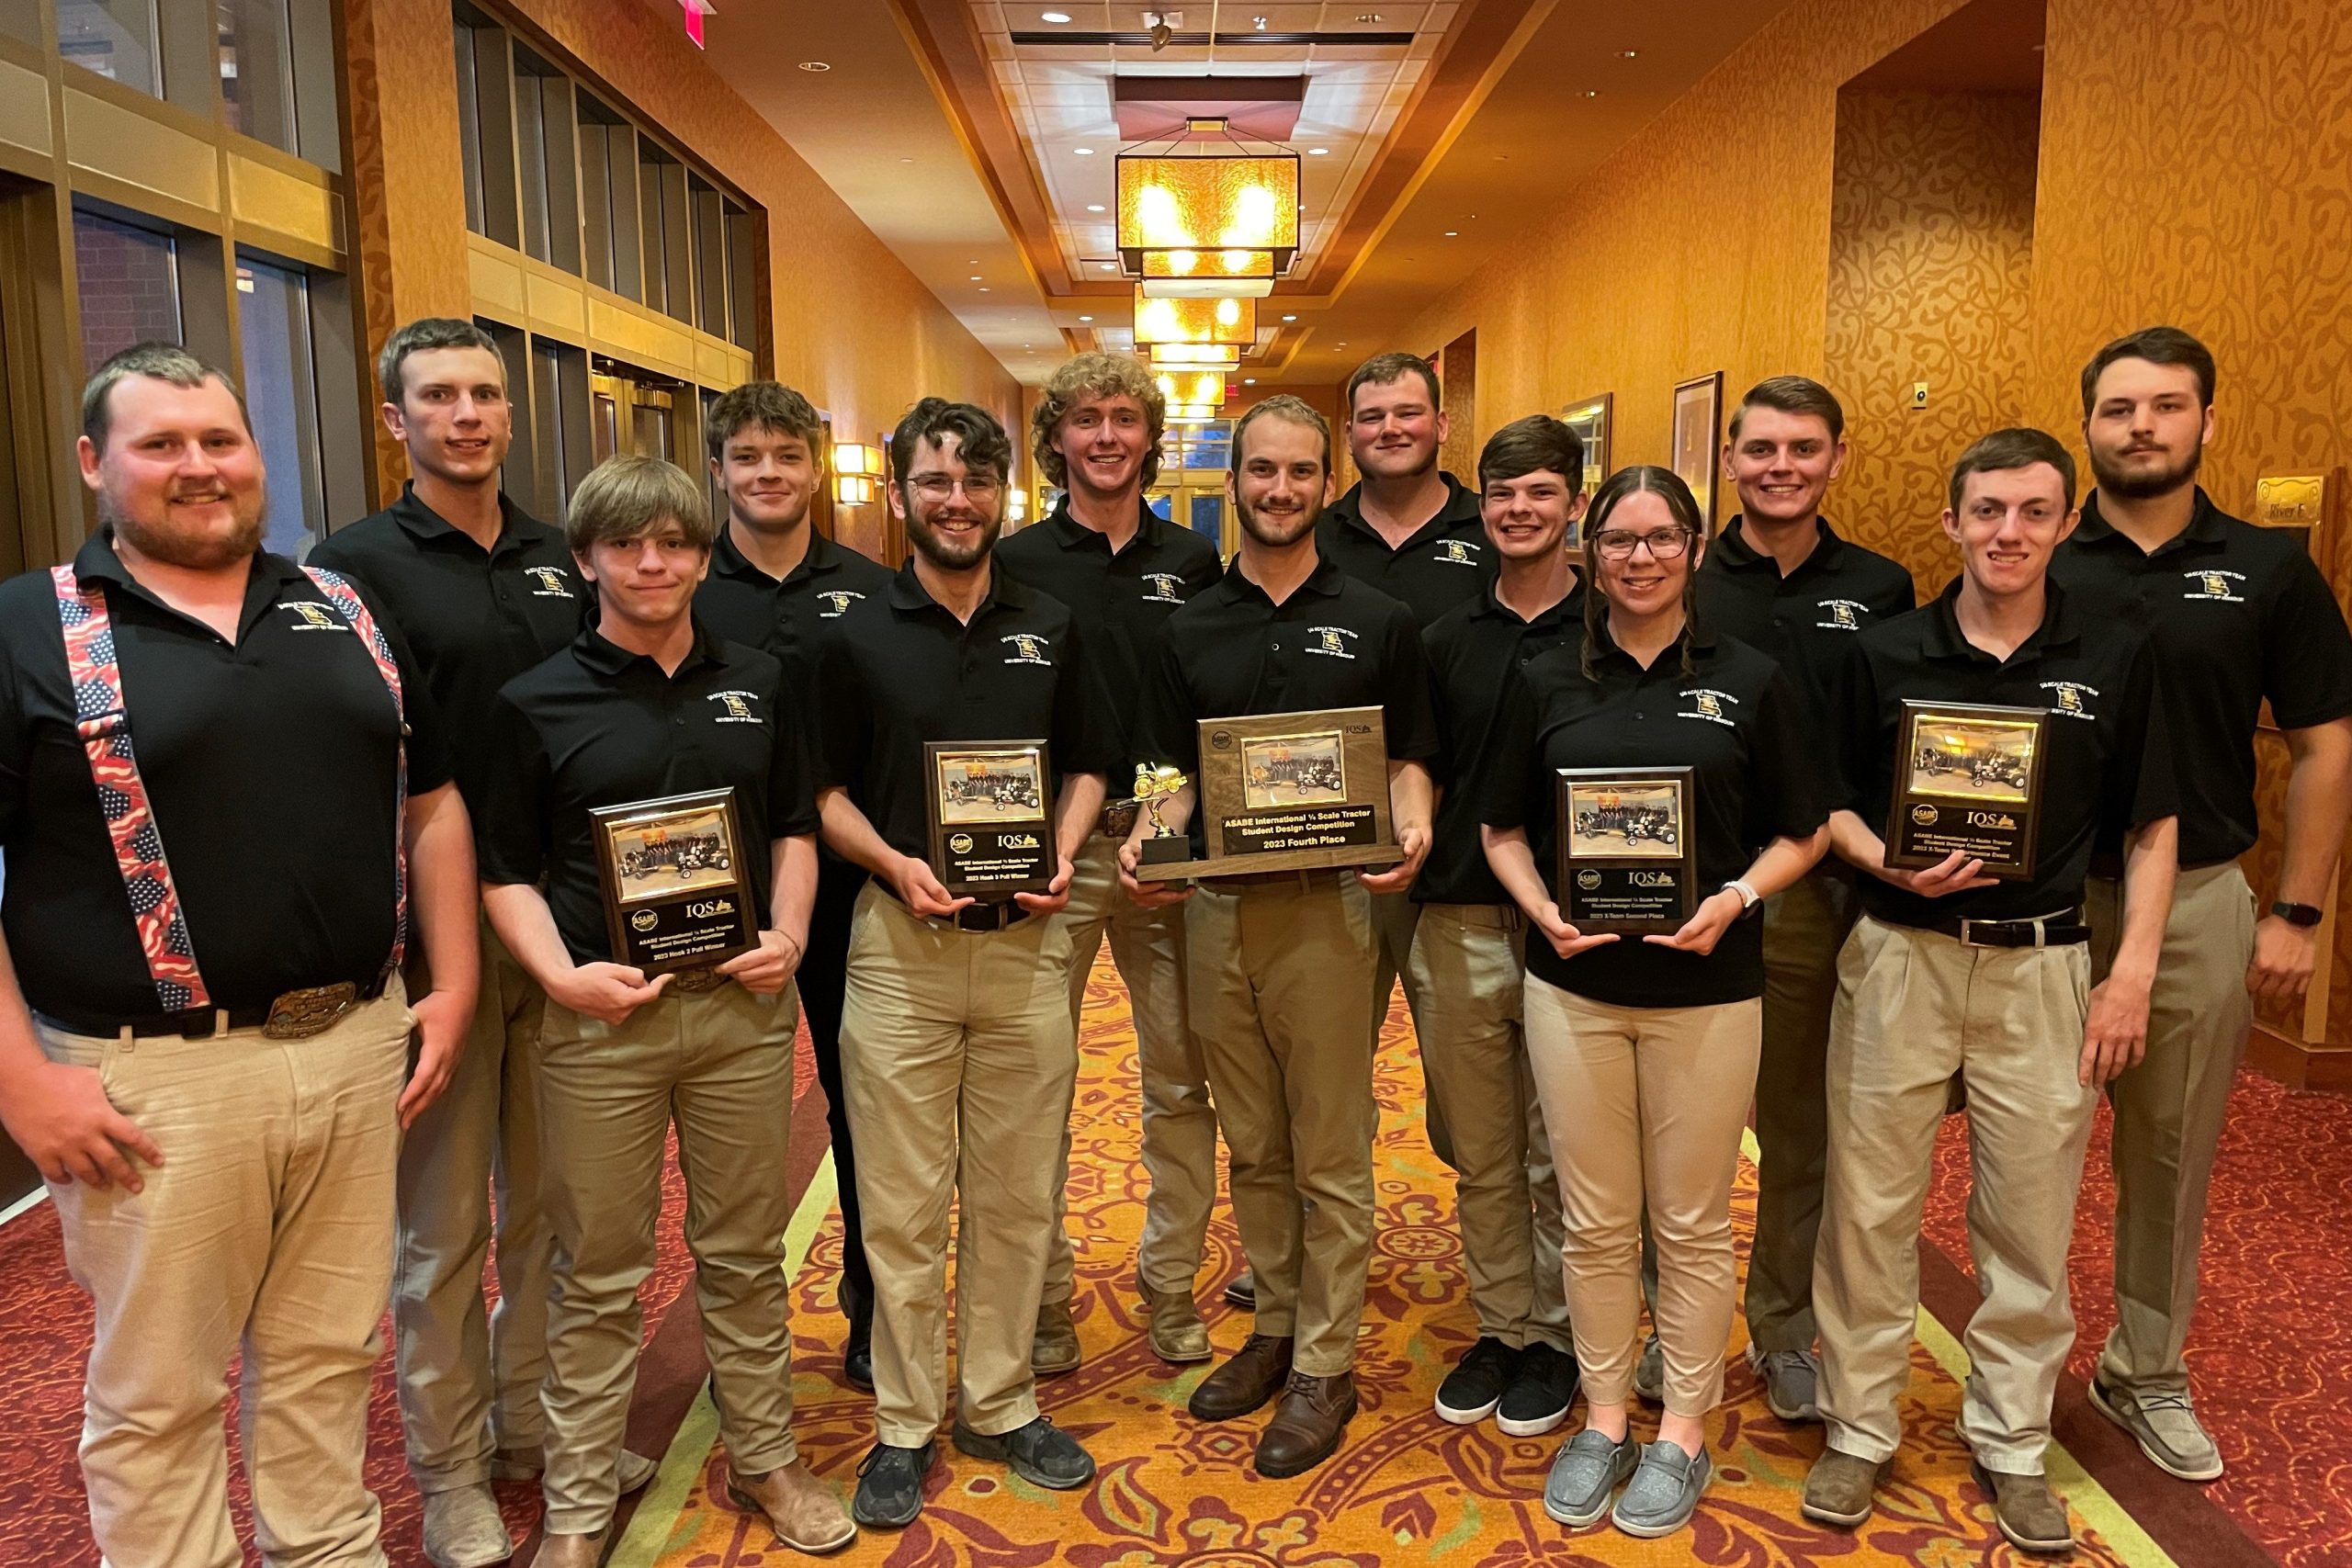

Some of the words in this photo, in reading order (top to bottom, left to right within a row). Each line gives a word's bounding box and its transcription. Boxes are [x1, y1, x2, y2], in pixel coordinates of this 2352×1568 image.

[1225, 818, 1254, 828] ASABE
[1255, 815, 1306, 826] International
[1317, 812, 1340, 820] Scale
[1341, 810, 1371, 818] Tractor
[1967, 812, 1997, 828] IQS
[1242, 828, 1274, 836] Student
[1276, 825, 1304, 833] Design
[1306, 820, 1355, 830] Competition
[998, 835, 1023, 849] IQS
[1263, 840, 1286, 849] 2023
[1288, 837, 1317, 847] Fourth
[1320, 835, 1346, 844] Place
[1628, 872, 1656, 886] IQS
[685, 901, 715, 919] IQS
[633, 914, 656, 924] ASABE
